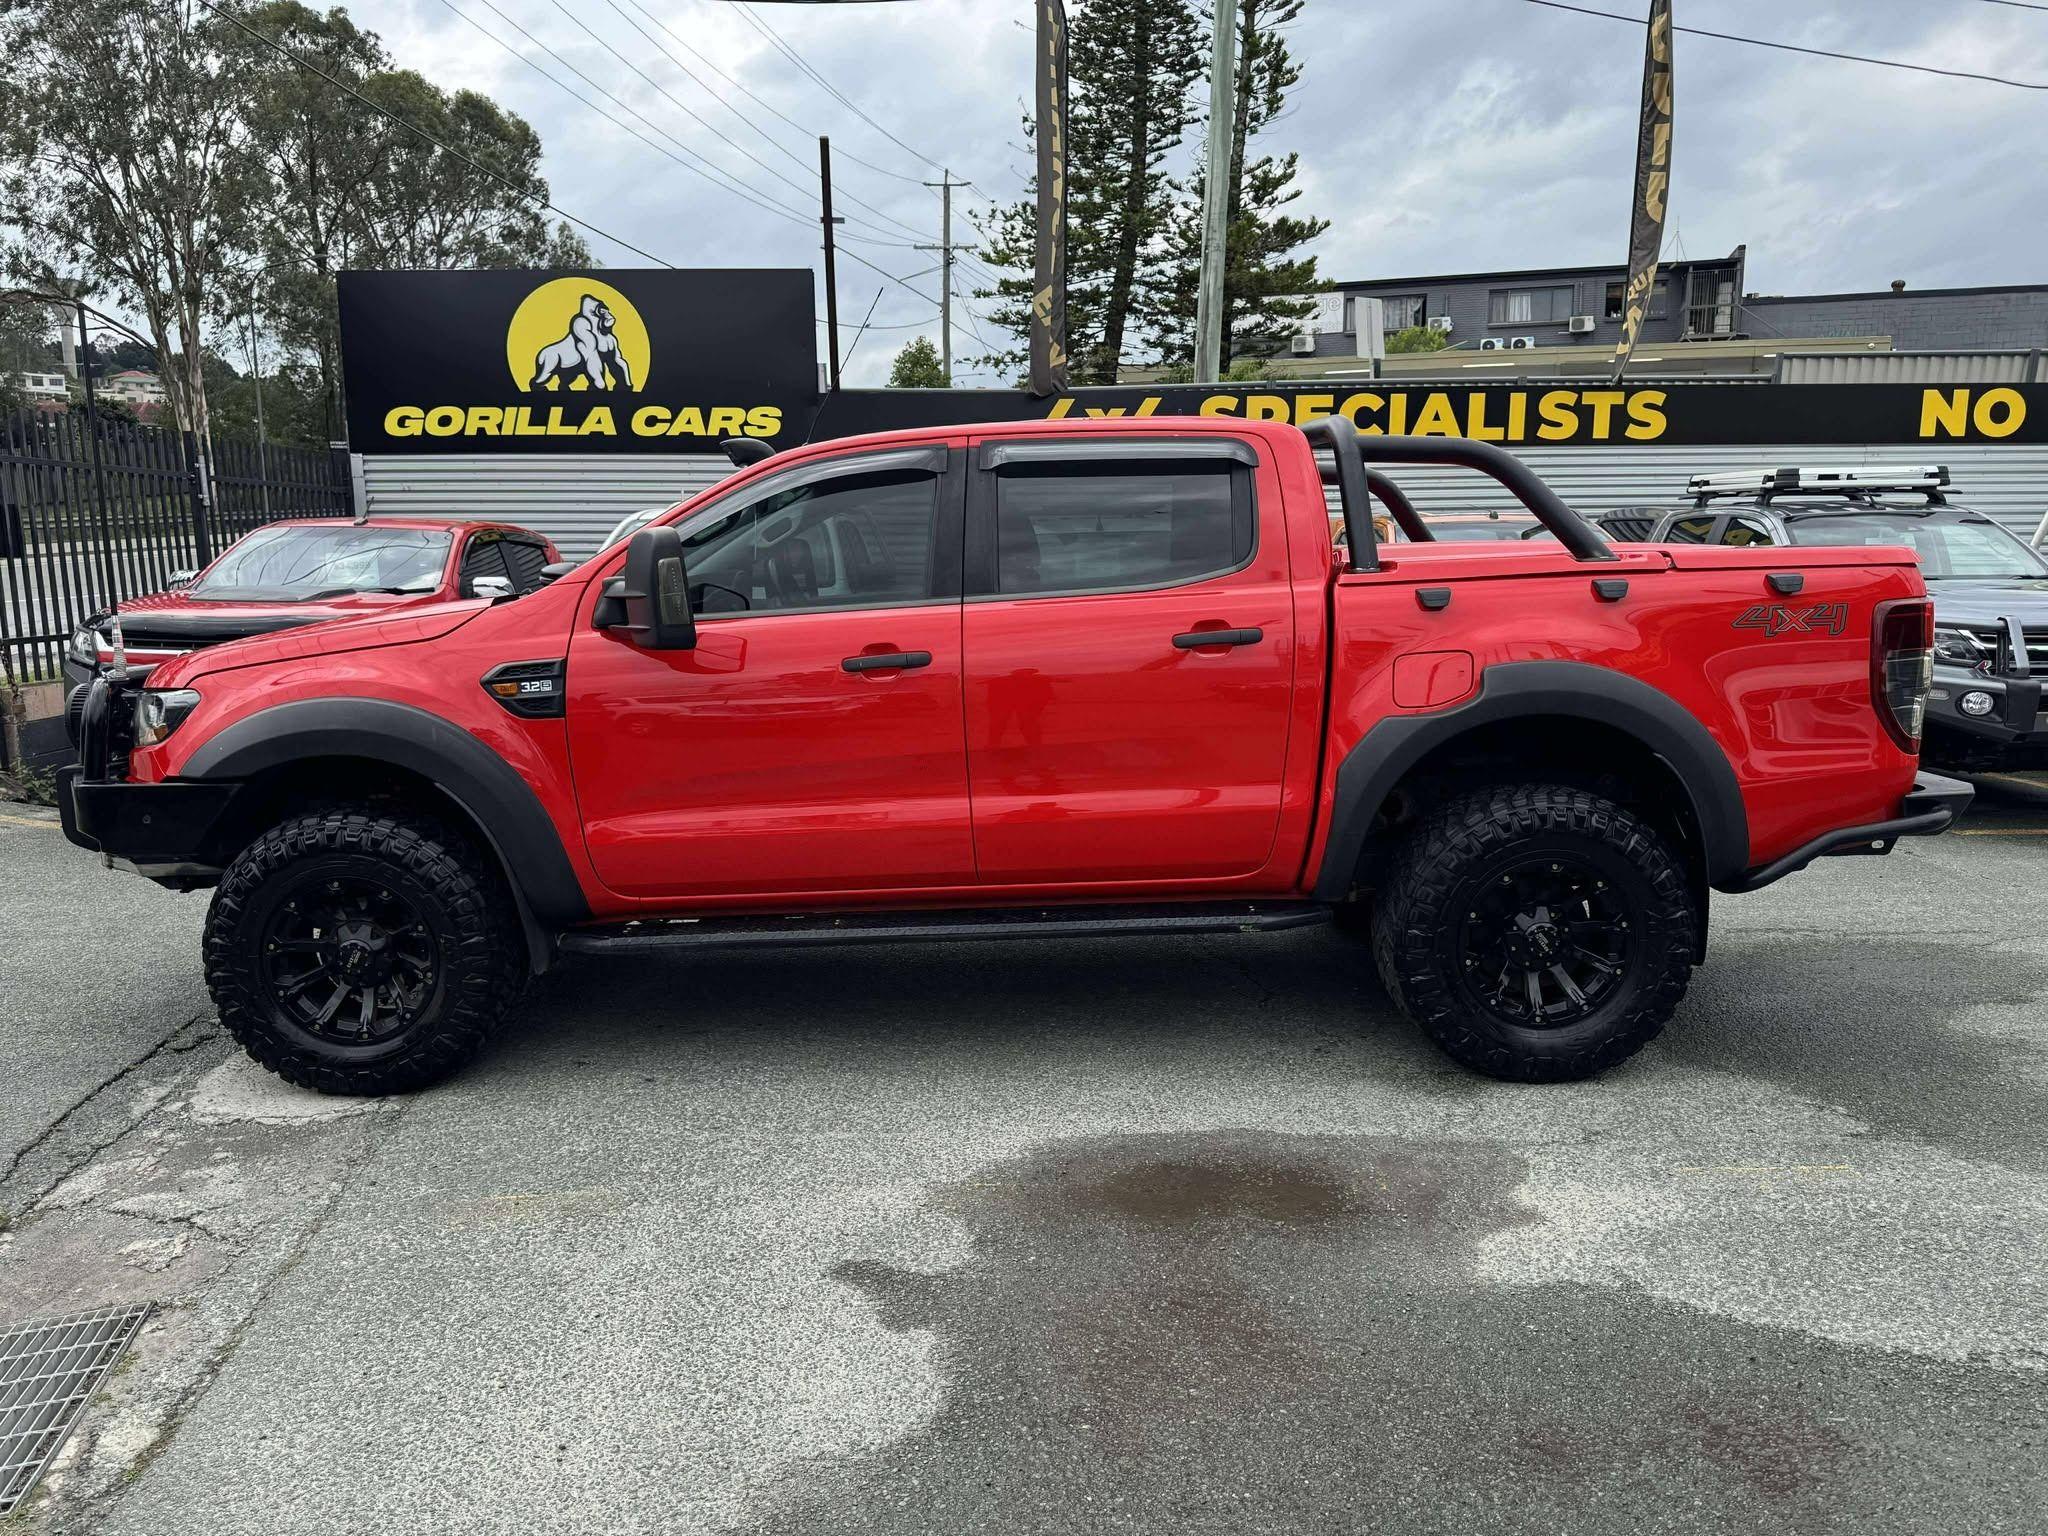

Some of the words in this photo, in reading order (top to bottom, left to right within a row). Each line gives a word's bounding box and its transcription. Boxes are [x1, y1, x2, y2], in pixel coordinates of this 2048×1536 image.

[385, 407, 615, 436] GORILLA
[632, 406, 781, 436] CARS
[1920, 388, 2026, 437] NO
